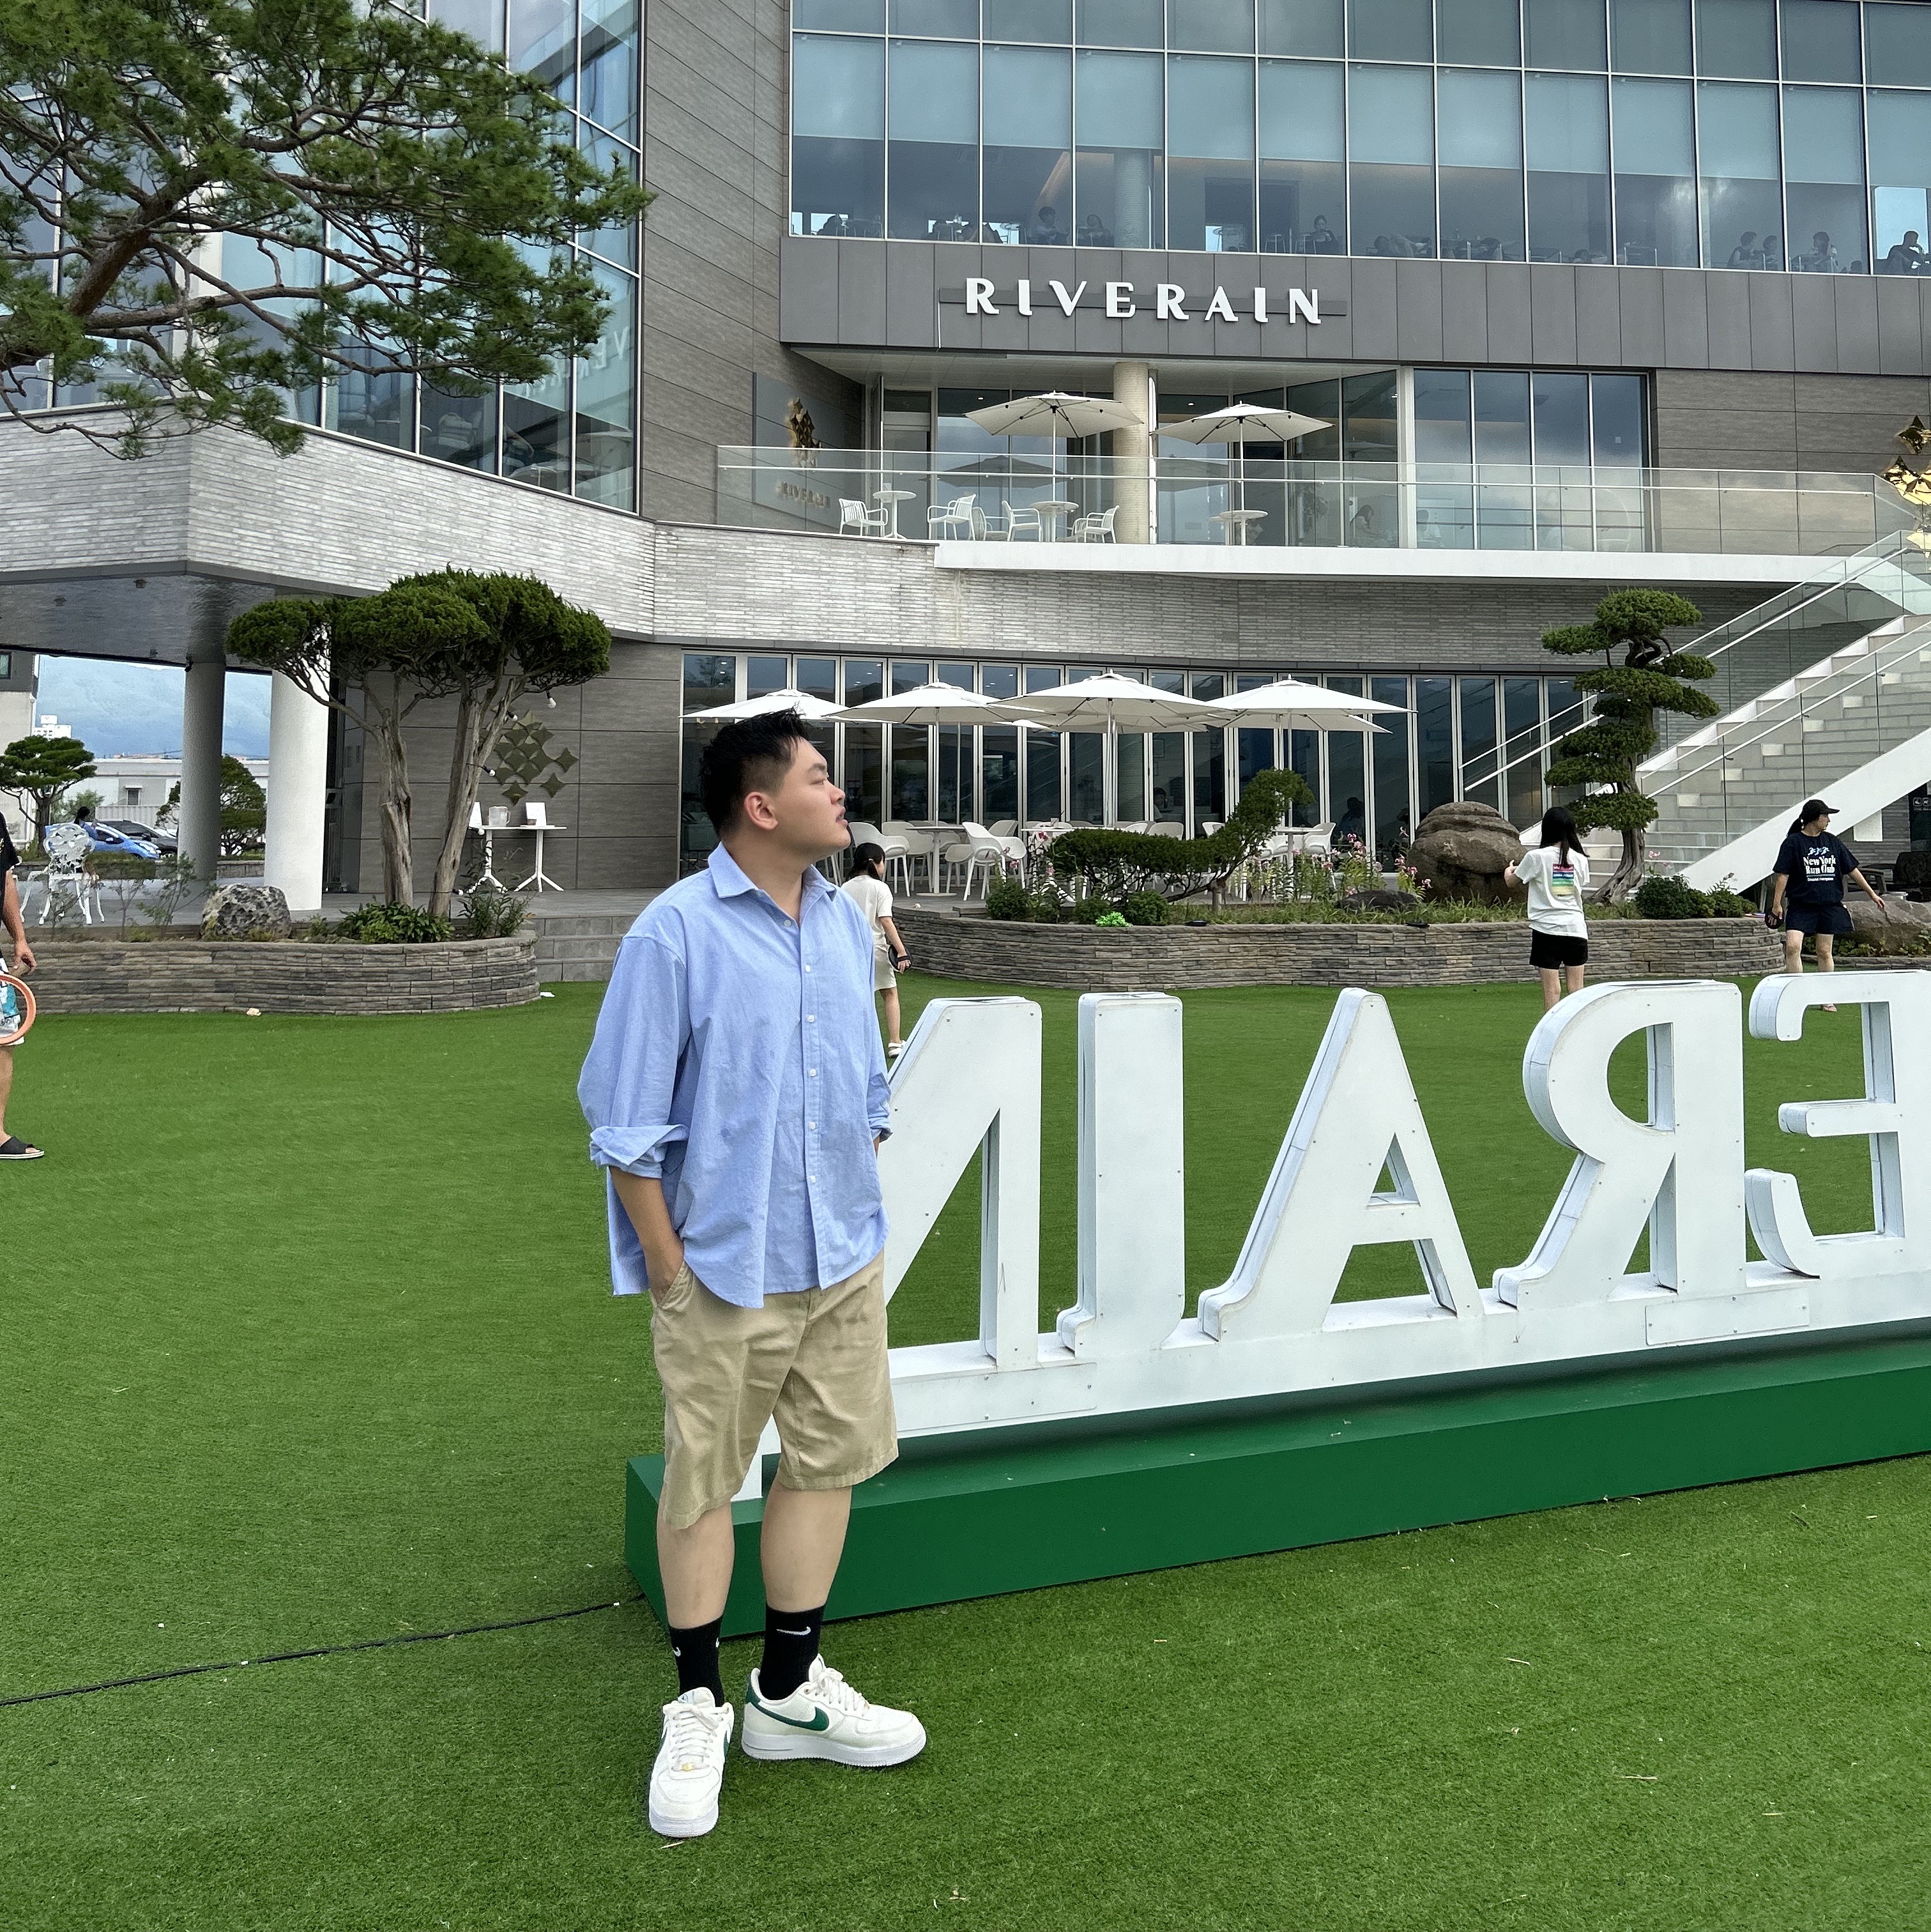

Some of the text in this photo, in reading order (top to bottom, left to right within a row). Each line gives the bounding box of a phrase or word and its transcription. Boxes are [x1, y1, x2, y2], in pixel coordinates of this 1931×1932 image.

[965, 277, 1322, 325] RIVERAIN
[1803, 855, 1836, 866] New York
[1806, 864, 1835, 874] Run Club
